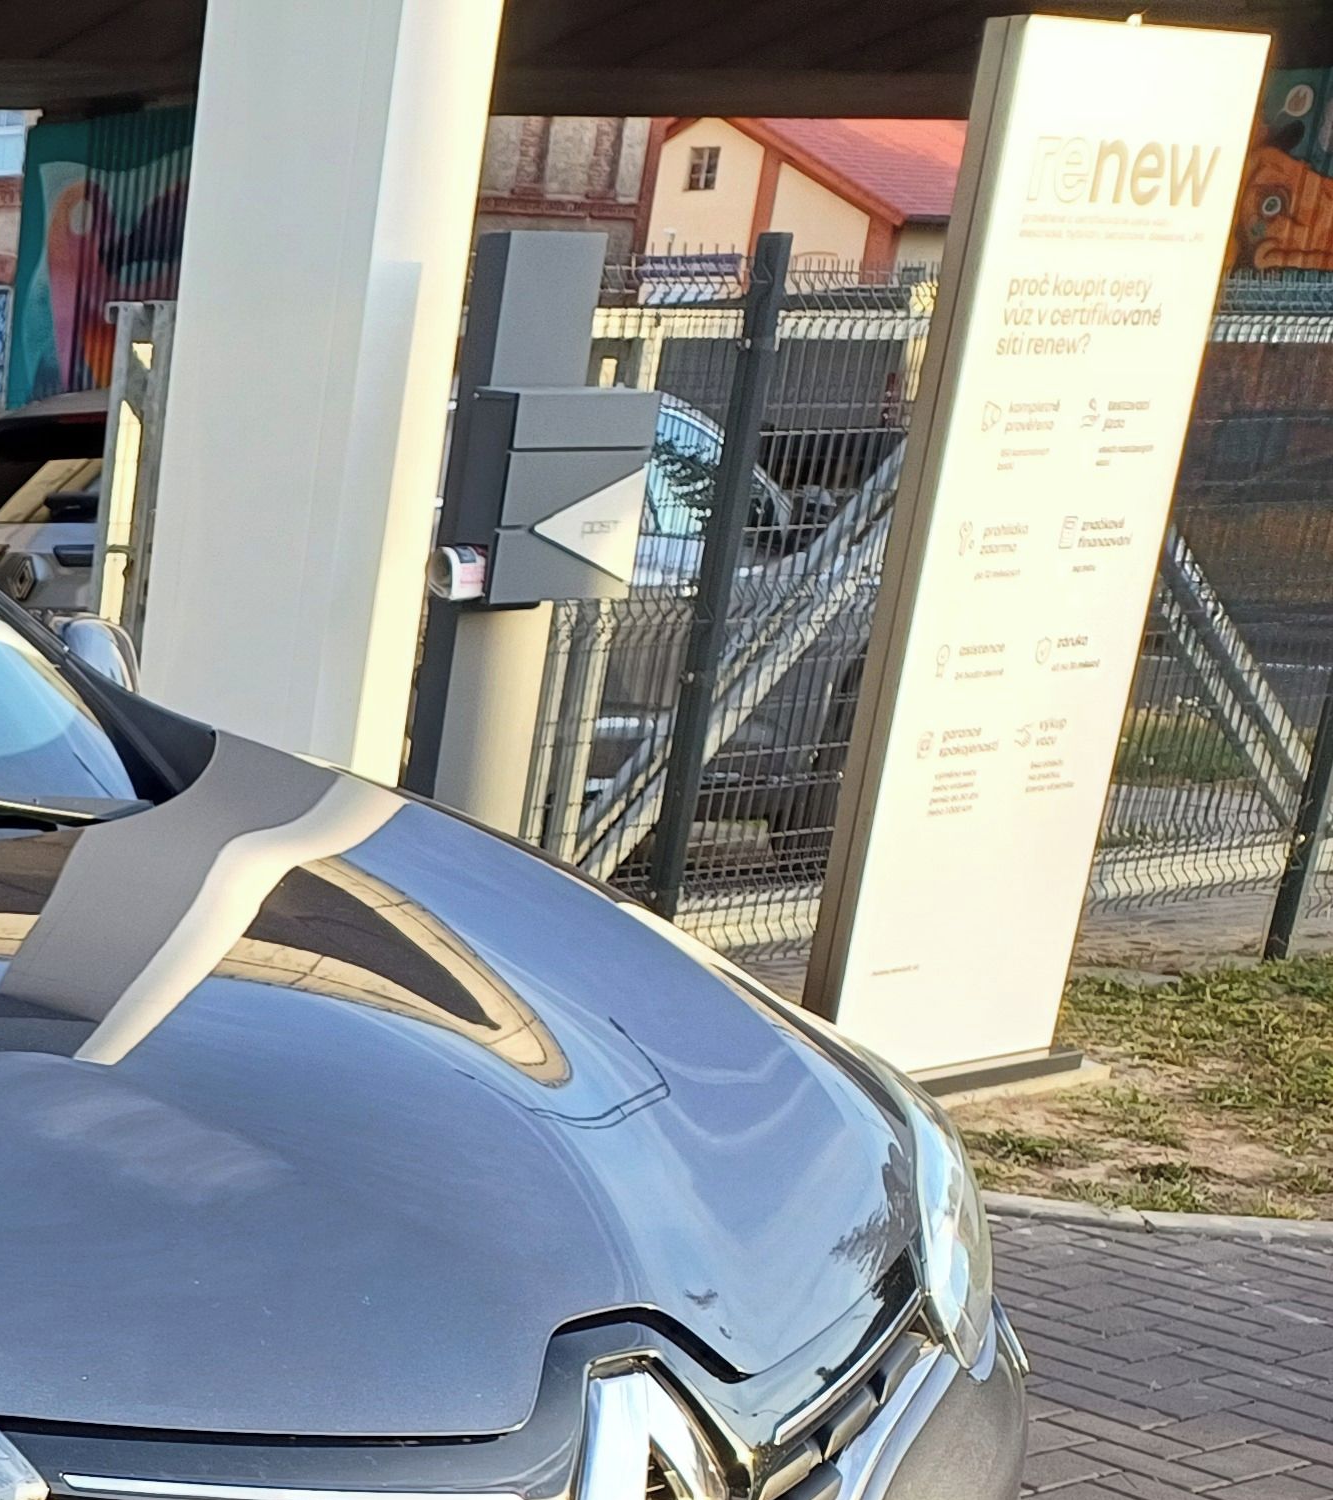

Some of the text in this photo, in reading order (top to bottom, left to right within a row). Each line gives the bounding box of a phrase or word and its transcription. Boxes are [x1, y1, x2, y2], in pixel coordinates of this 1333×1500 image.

[1026, 136, 1222, 207] renew
[1052, 273, 1107, 301] koupit
[1037, 310, 1047, 326] v
[1050, 301, 1163, 327] certifikované
[1027, 332, 1092, 355] renew?
